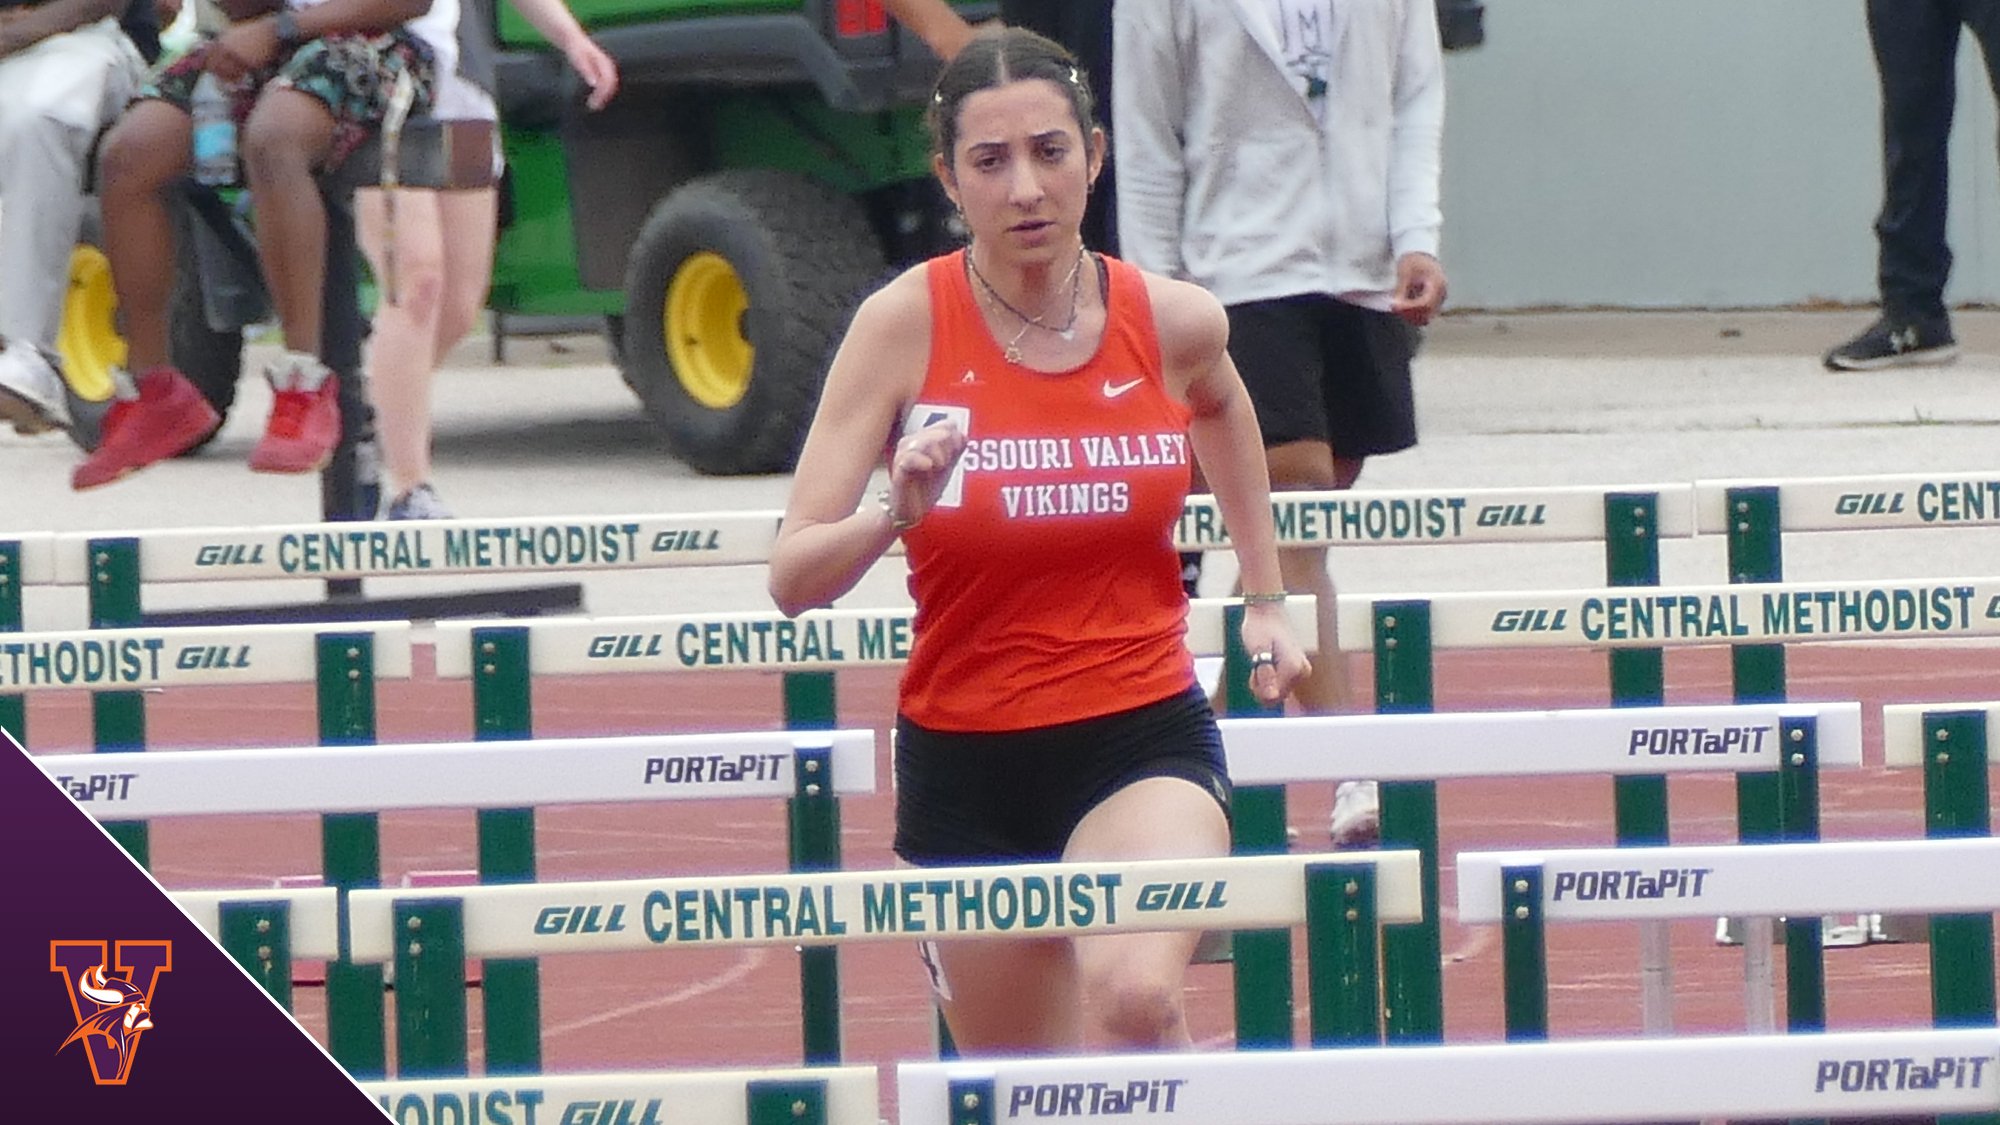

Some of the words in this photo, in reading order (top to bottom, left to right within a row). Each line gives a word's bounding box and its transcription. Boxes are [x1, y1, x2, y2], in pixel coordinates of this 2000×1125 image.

[1080, 433, 1187, 468] VALLEY
[1001, 482, 1130, 519] VIKINGS
[1271, 498, 1466, 541] METHODIST
[1476, 504, 1547, 528] GILL
[1835, 492, 1905, 515] GILL
[194, 543, 264, 567] GILL
[278, 530, 431, 573] CENTRAL
[444, 523, 640, 567] METHODIST
[651, 529, 722, 552] GILL
[1491, 608, 1567, 633] GILL
[1580, 594, 1750, 641] CENTRAL
[1762, 586, 1975, 635] METHODIST
[0, 638, 164, 685] THODIST
[176, 645, 252, 669] GILL
[587, 633, 662, 658] GILL
[676, 618, 844, 667] CENTRAL
[533, 904, 626, 935] GILL
[643, 885, 847, 944] CENTRAL
[862, 873, 1122, 933] METHODIST
[1136, 881, 1228, 911] GILL
[379, 1090, 544, 1125] ODIST
[559, 1099, 664, 1125] GILL
